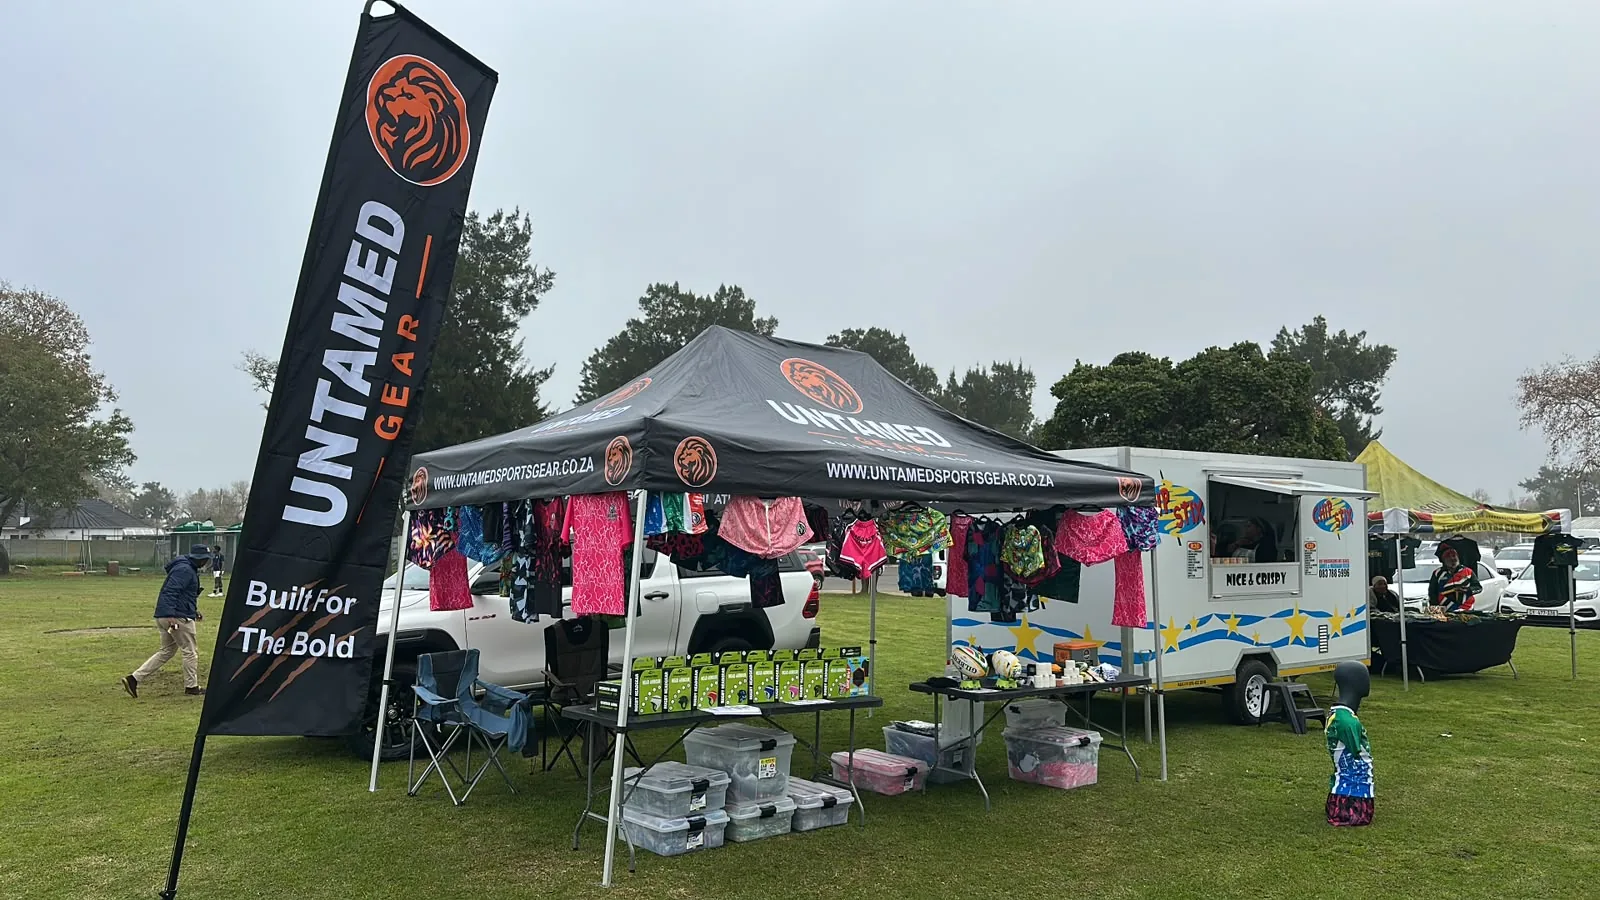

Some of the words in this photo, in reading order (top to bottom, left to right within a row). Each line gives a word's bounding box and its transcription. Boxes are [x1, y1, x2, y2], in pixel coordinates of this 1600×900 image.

[282, 200, 405, 527] UNTAMED
[374, 314, 419, 440] GEAR
[766, 399, 952, 447] UNTAMED
[433, 456, 594, 490] WWW.UNTAMEDSPORTSGEAR.CO.ZA
[826, 462, 1054, 487] WWW.UNTAMEDSPORTSGEAR.CO.ZA
[1227, 573, 1246, 586] NICE
[1248, 573, 1253, 585] &
[1256, 571, 1286, 585] CRISPY
[245, 580, 313, 612] Built
[312, 589, 357, 615] For
[238, 627, 284, 655] The
[291, 631, 354, 658] Bold
